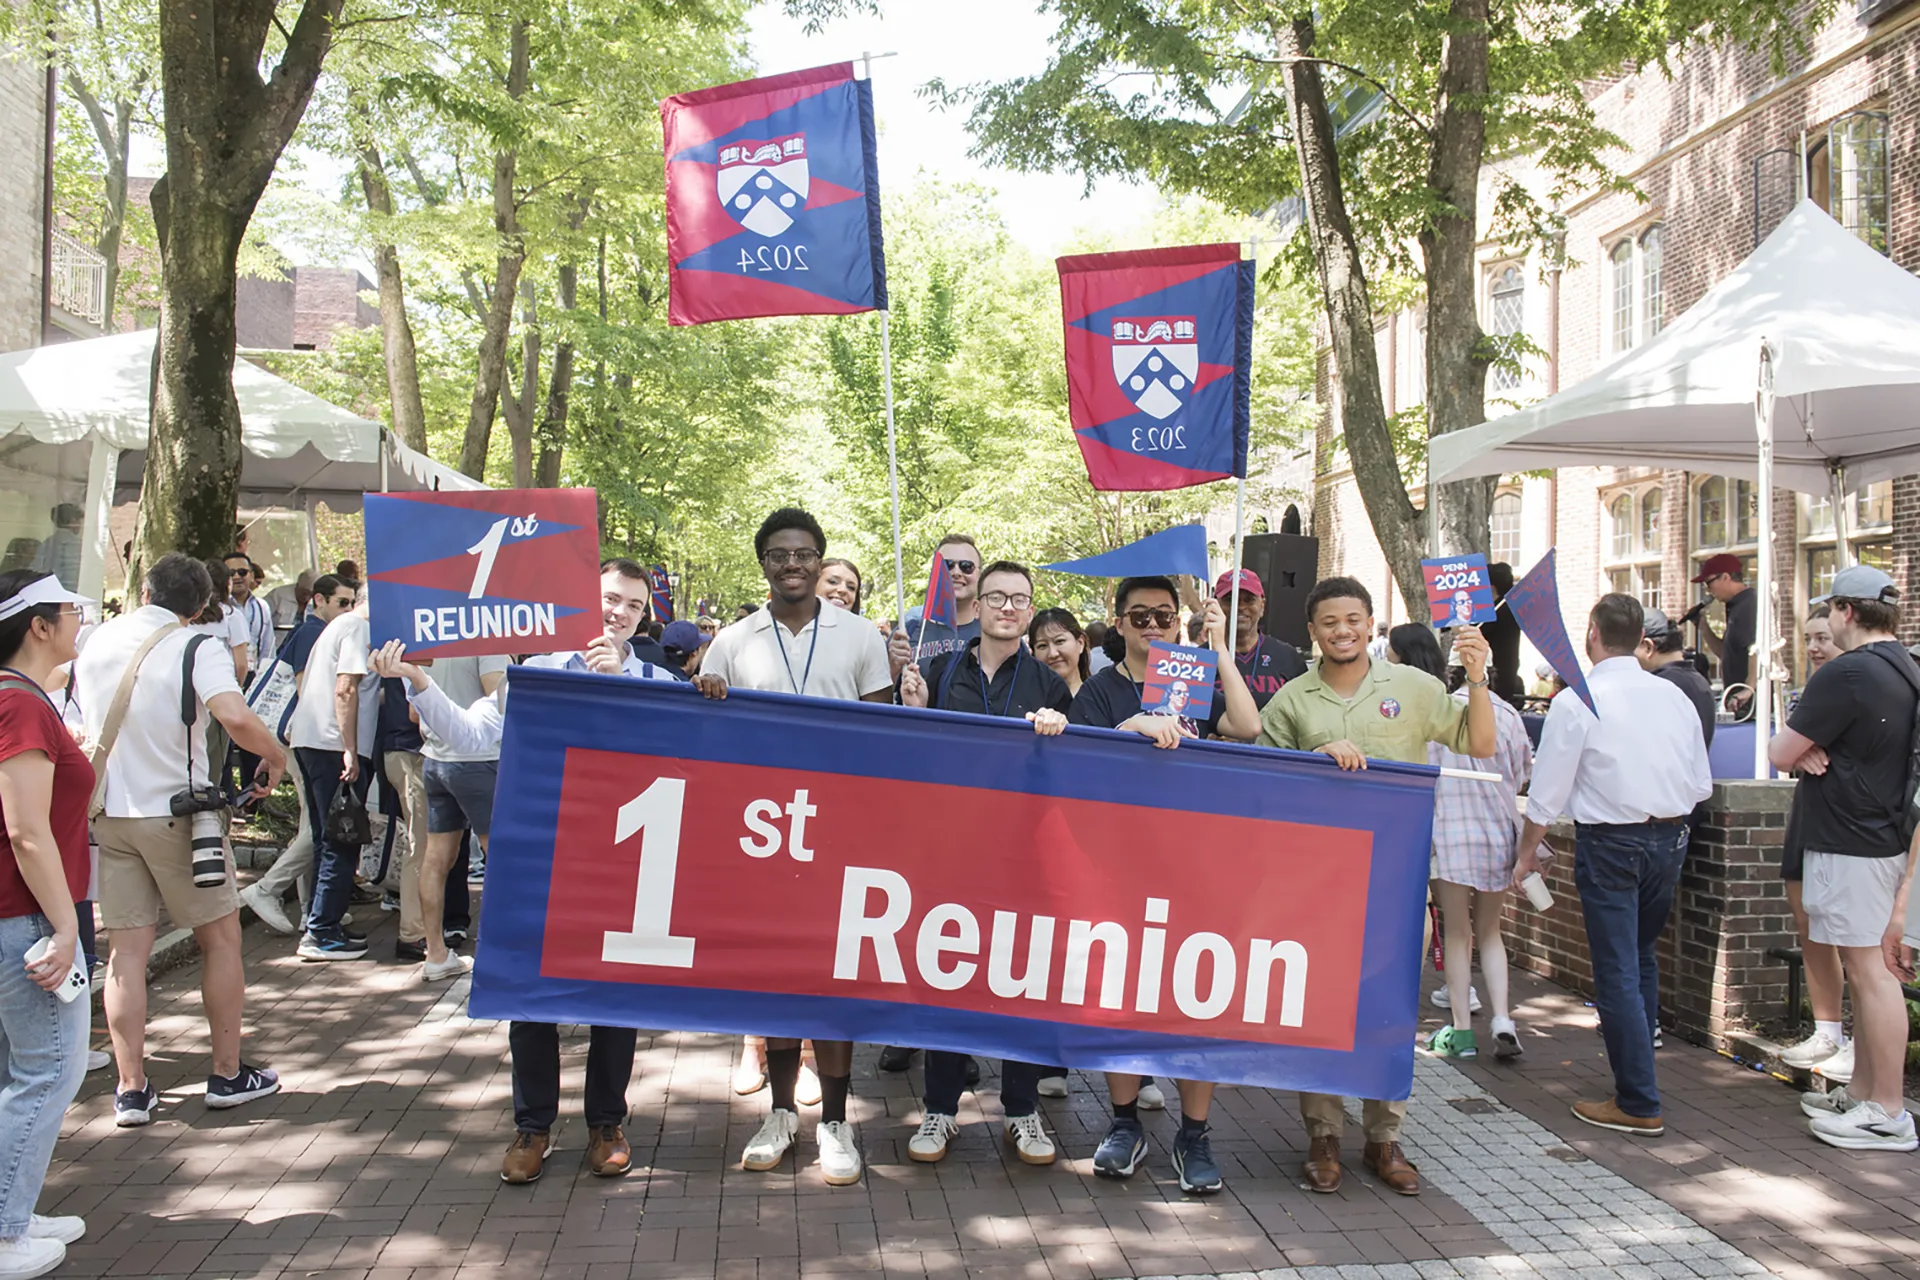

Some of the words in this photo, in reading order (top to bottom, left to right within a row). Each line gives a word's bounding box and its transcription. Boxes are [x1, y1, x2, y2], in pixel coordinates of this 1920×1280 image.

[1442, 562, 1468, 573] PENN
[1435, 571, 1480, 591] 2024
[414, 603, 556, 642] REUNION
[1170, 651, 1197, 663] PENN
[1156, 659, 1205, 682] 2024
[833, 866, 1308, 1027] Reunion
[246, 1073, 262, 1090] N
